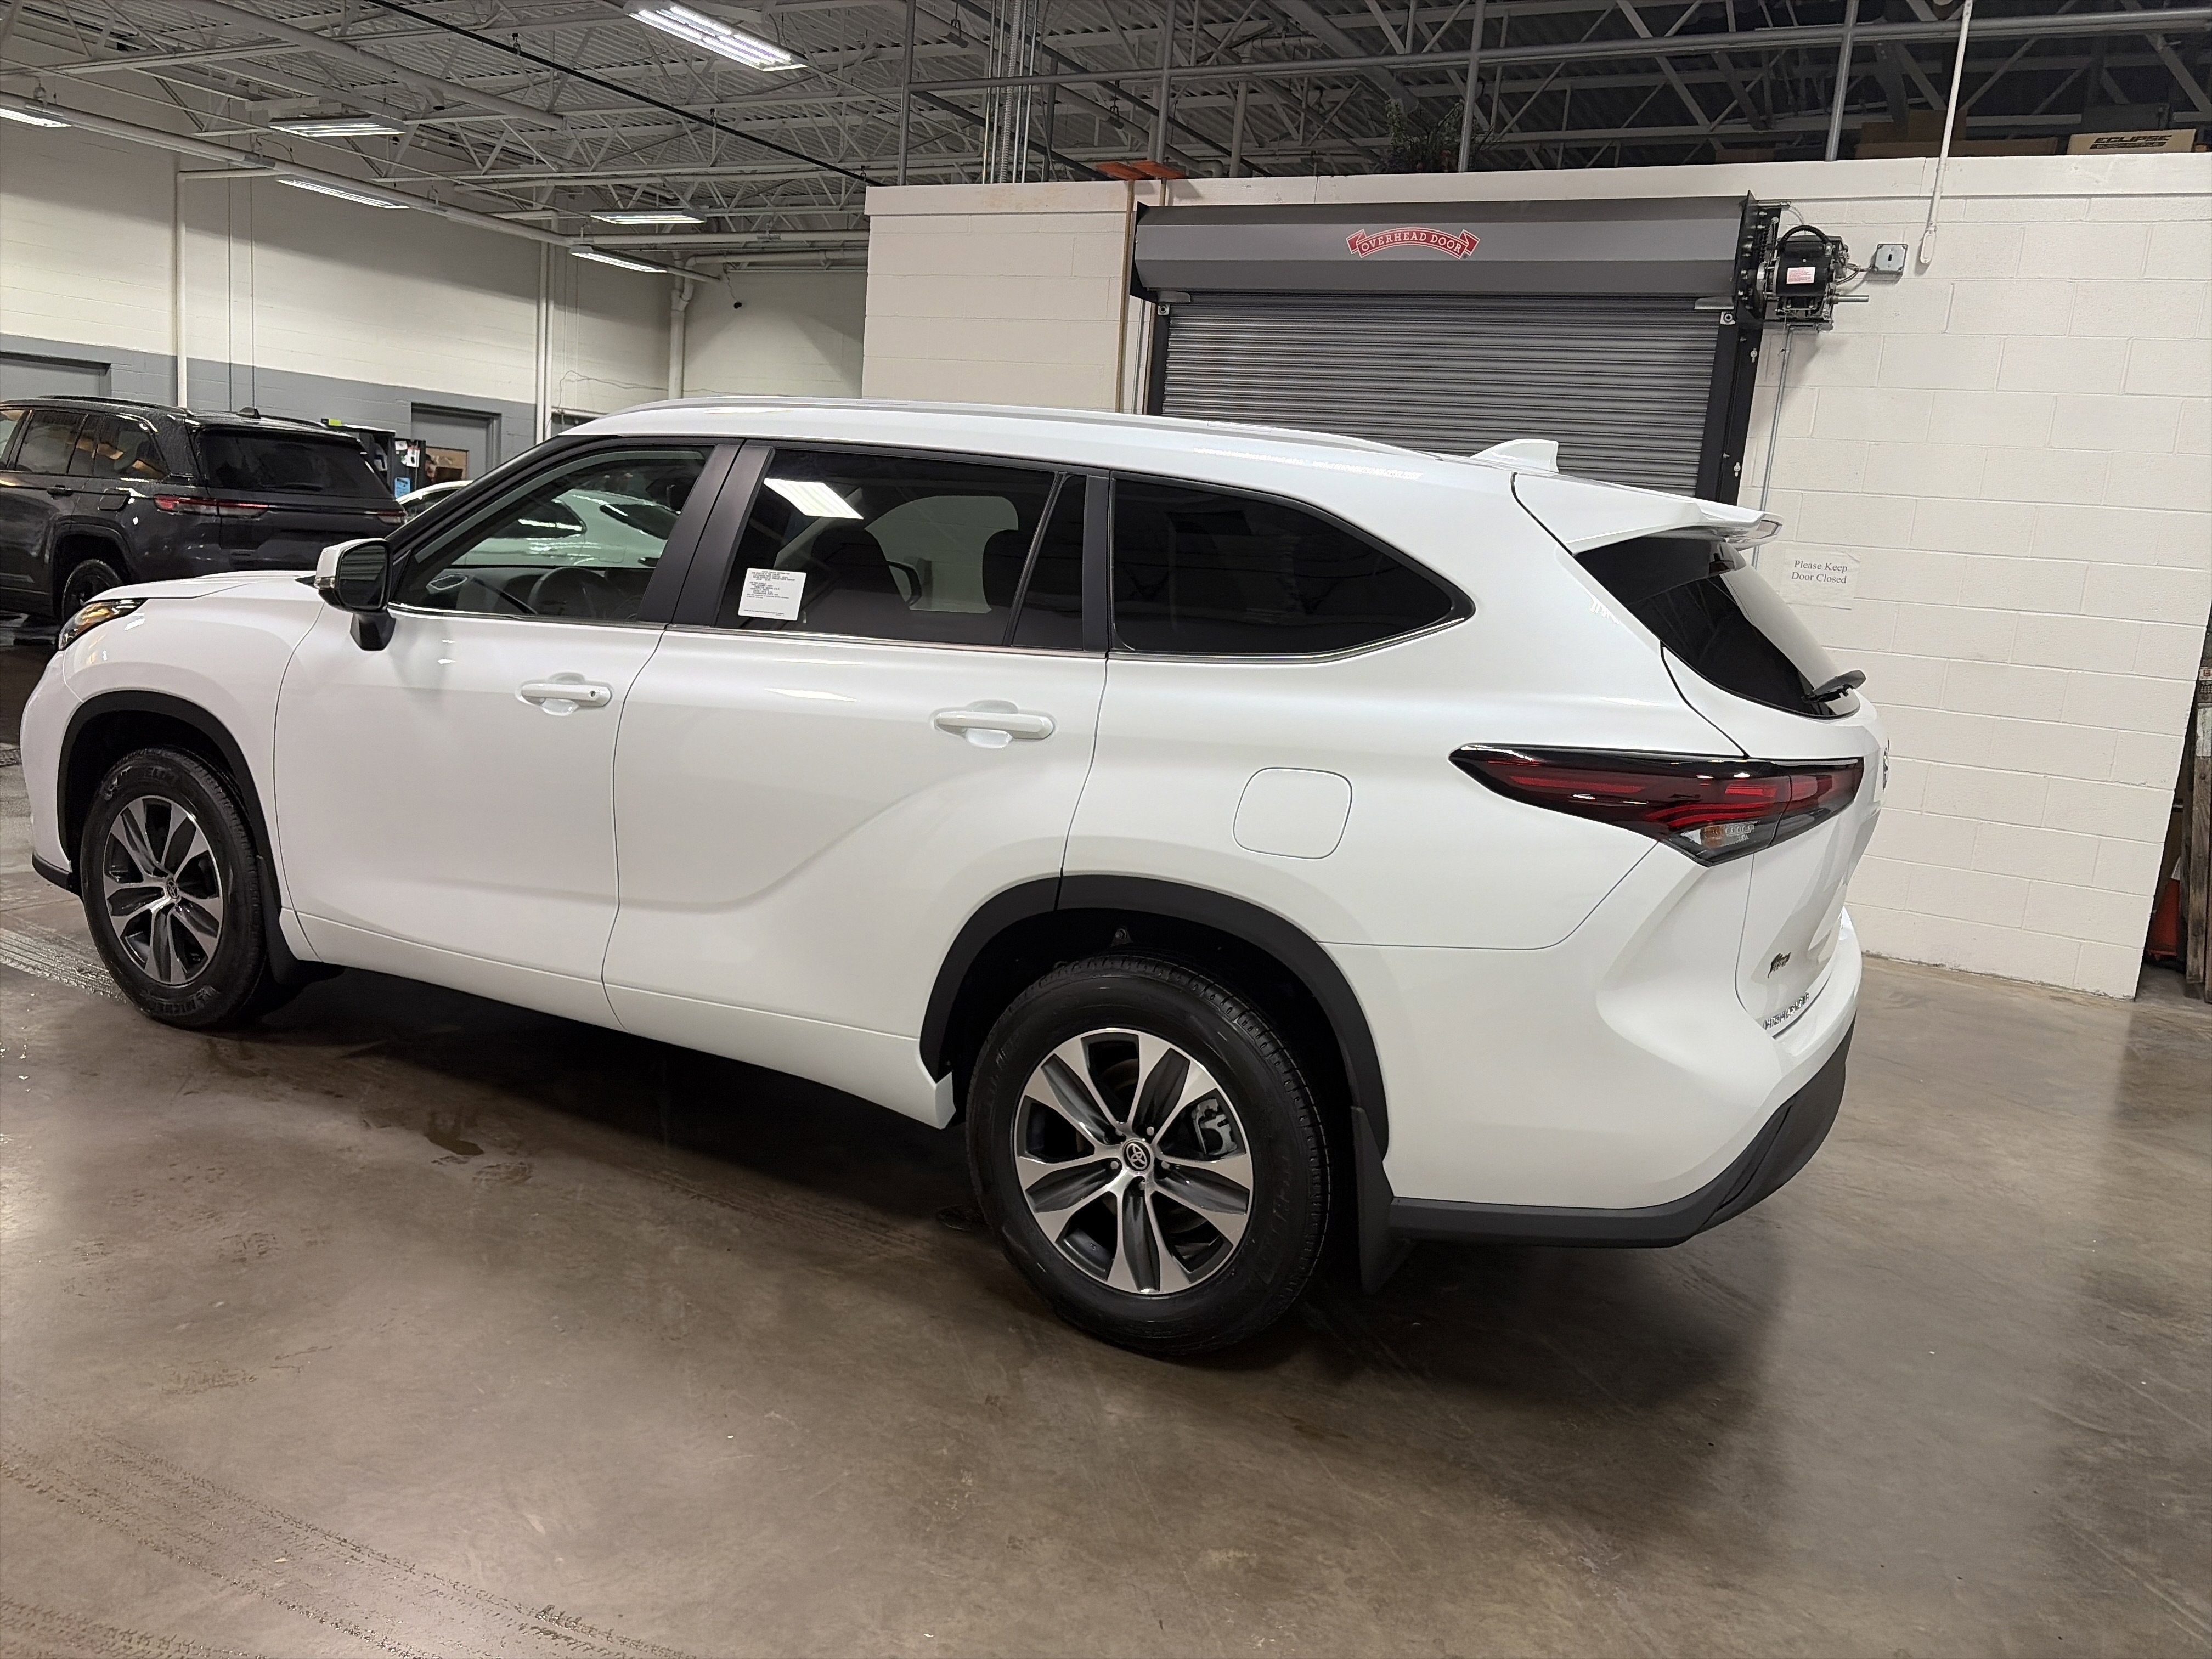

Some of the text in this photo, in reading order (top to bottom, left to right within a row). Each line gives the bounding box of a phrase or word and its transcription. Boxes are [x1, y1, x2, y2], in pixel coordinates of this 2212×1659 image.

[2094, 134, 2173, 143] ECLIPSE
[1361, 232, 1462, 253] OVERHEAD DOOR
[1794, 560, 1848, 574] Please Keep
[1791, 571, 1847, 584] Door Closed
